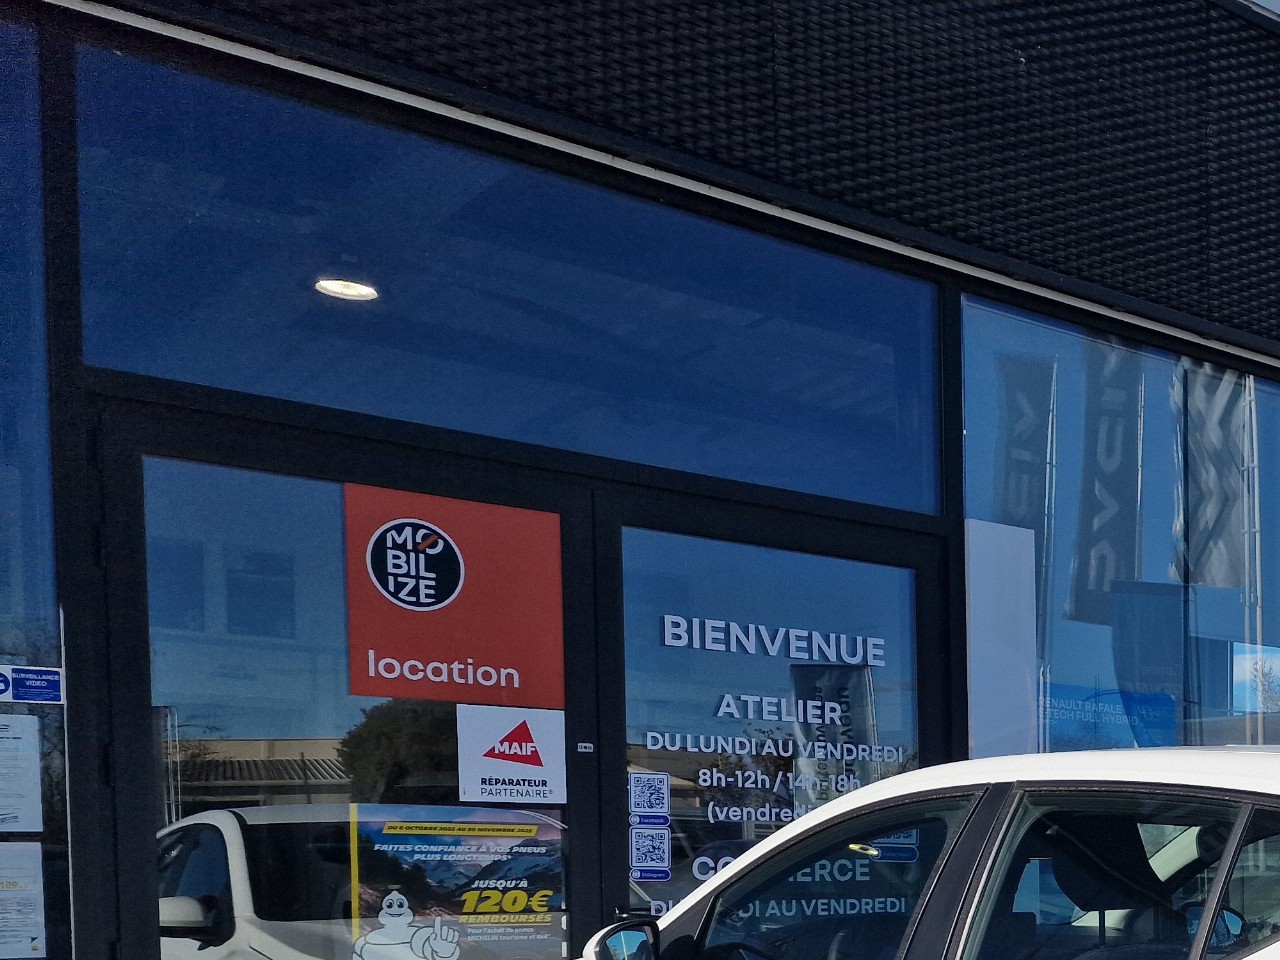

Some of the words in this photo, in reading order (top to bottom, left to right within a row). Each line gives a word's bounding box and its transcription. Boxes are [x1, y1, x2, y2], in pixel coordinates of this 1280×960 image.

[663, 614, 886, 667] BIENVENUE
[367, 649, 520, 688] location
[716, 693, 843, 725] ATELIER
[1086, 702, 1122, 714] RAFALE
[494, 741, 537, 756] MAIF
[646, 731, 682, 751] DU
[686, 733, 758, 756] LUNDI
[761, 738, 793, 758] AU
[800, 741, 903, 763] VENDREDI
[480, 775, 548, 788] RÉPARATEUR
[698, 767, 770, 789] 8h-12h
[787, 771, 861, 793] 14h-18h
[374, 844, 413, 852] FAITES
[414, 844, 477, 853] CONFIANCE
[490, 845, 511, 854] VOS
[512, 846, 547, 854] PNEUS
[413, 853, 442, 861] PLUS
[471, 878, 528, 890] JUSQU'À
[460, 889, 554, 913] 120€
[765, 900, 796, 917] AU
[802, 897, 906, 917] VENDREDI
[459, 912, 552, 923] REMBOURSÉS
